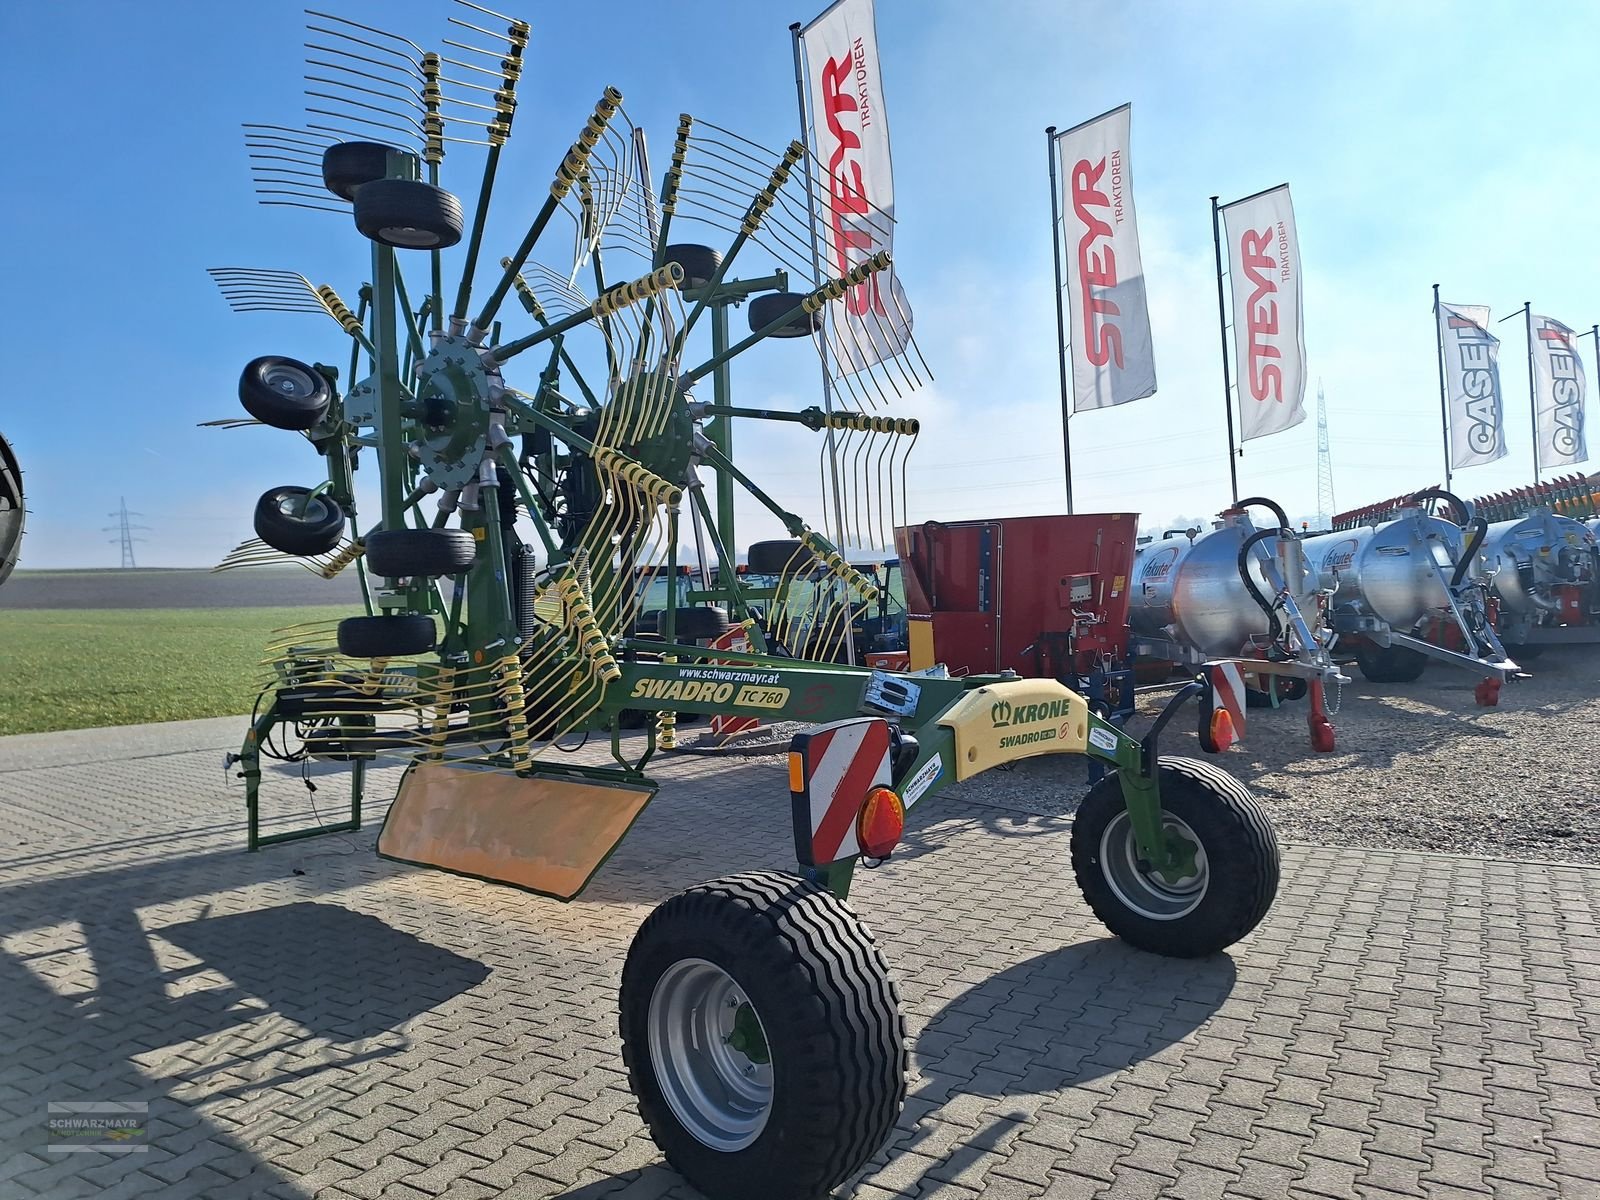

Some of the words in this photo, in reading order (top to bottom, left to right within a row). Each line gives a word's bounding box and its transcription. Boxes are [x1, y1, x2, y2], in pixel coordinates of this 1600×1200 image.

[853, 36, 871, 131] TRAKTOREN
[1111, 149, 1124, 225] TRAKTOREN
[1071, 156, 1125, 370] STEYR
[1277, 221, 1290, 283] TRAKTOREN
[1241, 226, 1283, 403] STEYR
[1458, 342, 1497, 455] CASE
[1550, 353, 1582, 456] CASE
[630, 678, 735, 704] SWADRO
[741, 689, 757, 703] TC
[759, 690, 784, 705] 760
[679, 667, 780, 685] www.schwarzmayr.at
[1012, 699, 1071, 726] KRONE
[999, 731, 1040, 749] SWADRO
